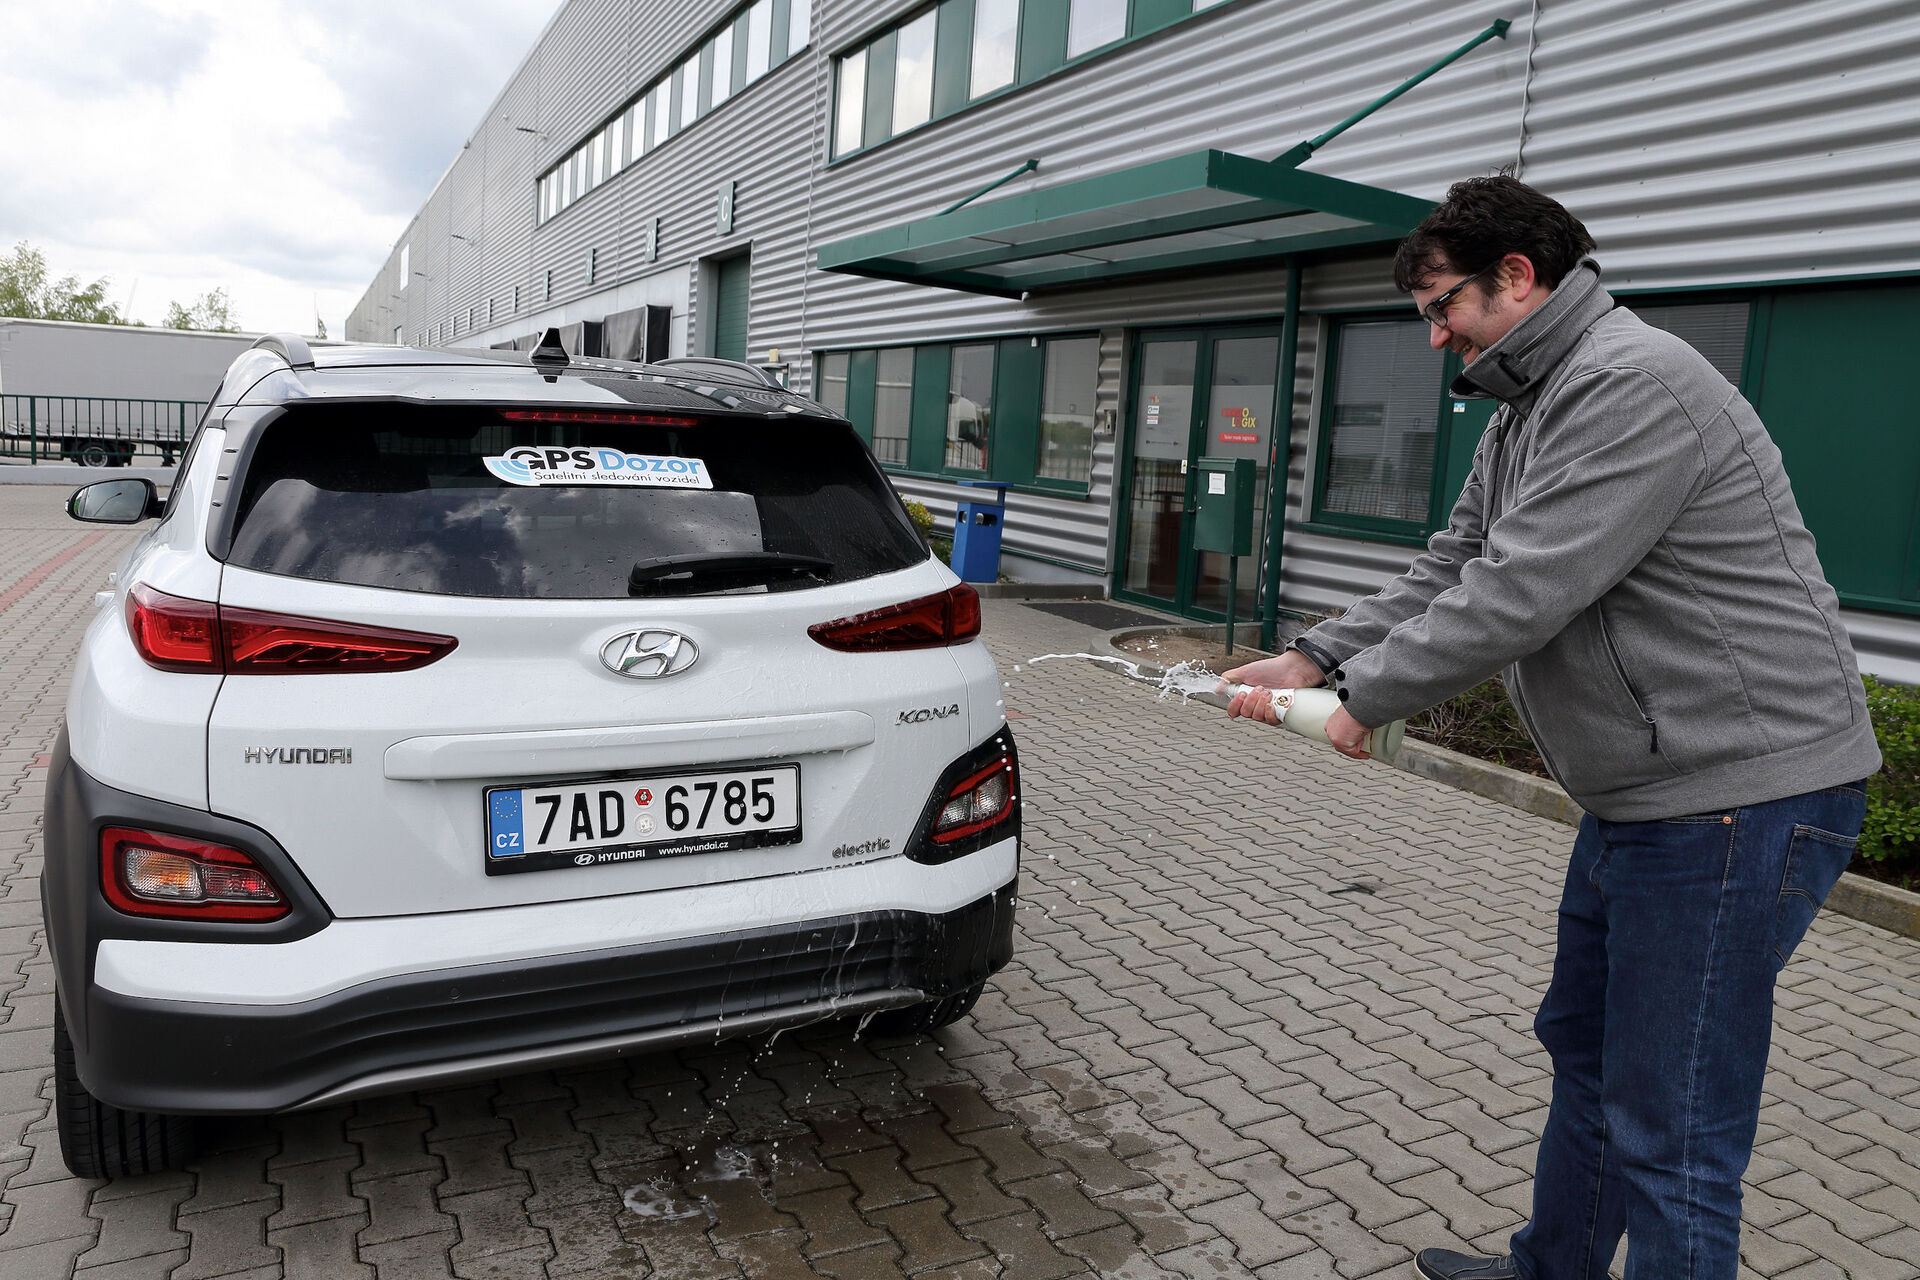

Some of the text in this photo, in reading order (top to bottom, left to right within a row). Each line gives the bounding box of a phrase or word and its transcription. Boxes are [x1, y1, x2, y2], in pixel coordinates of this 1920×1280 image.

[721, 195, 729, 222] C
[534, 471, 700, 484] Satelitní sledování vozidel
[895, 704, 960, 725] KONA
[244, 746, 352, 764] HYUNDAI
[534, 777, 775, 845] 7AD 6785
[496, 833, 519, 848] CZ
[658, 841, 729, 856] www.hyundai.cz
[831, 836, 891, 859] electric
[598, 849, 646, 862] HYUNDAI
